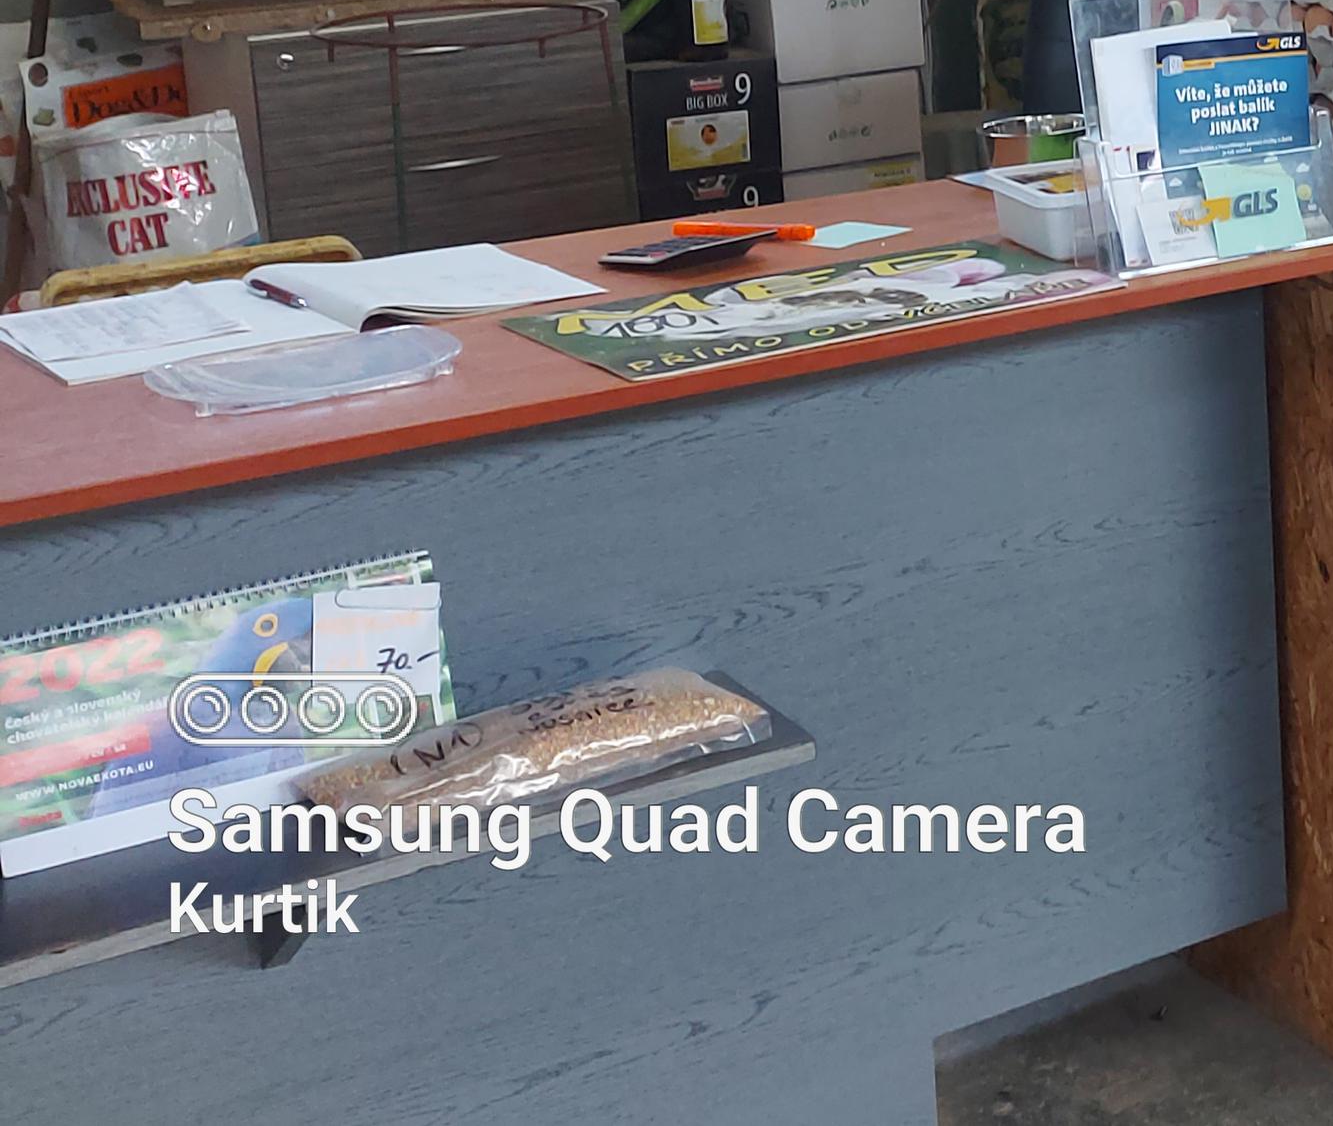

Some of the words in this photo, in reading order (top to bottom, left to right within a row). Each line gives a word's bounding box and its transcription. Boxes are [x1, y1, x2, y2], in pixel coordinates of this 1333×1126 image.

[1279, 36, 1301, 49] GLS
[686, 95, 705, 111] BIG
[706, 93, 729, 107] BOX
[735, 73, 752, 105] 9
[1175, 87, 1211, 104] Víte,
[1214, 82, 1231, 100] že
[1233, 78, 1288, 98] můžete
[1190, 101, 1236, 123] poslat
[1238, 96, 1275, 117] balík
[1208, 117, 1260, 136] JINAK?
[1233, 188, 1279, 220] GLS
[108, 212, 169, 257] CAT
[554, 248, 980, 337] MED
[626, 334, 783, 374] PŘÍMO
[809, 314, 872, 338] OD
[0, 628, 166, 704] 2022
